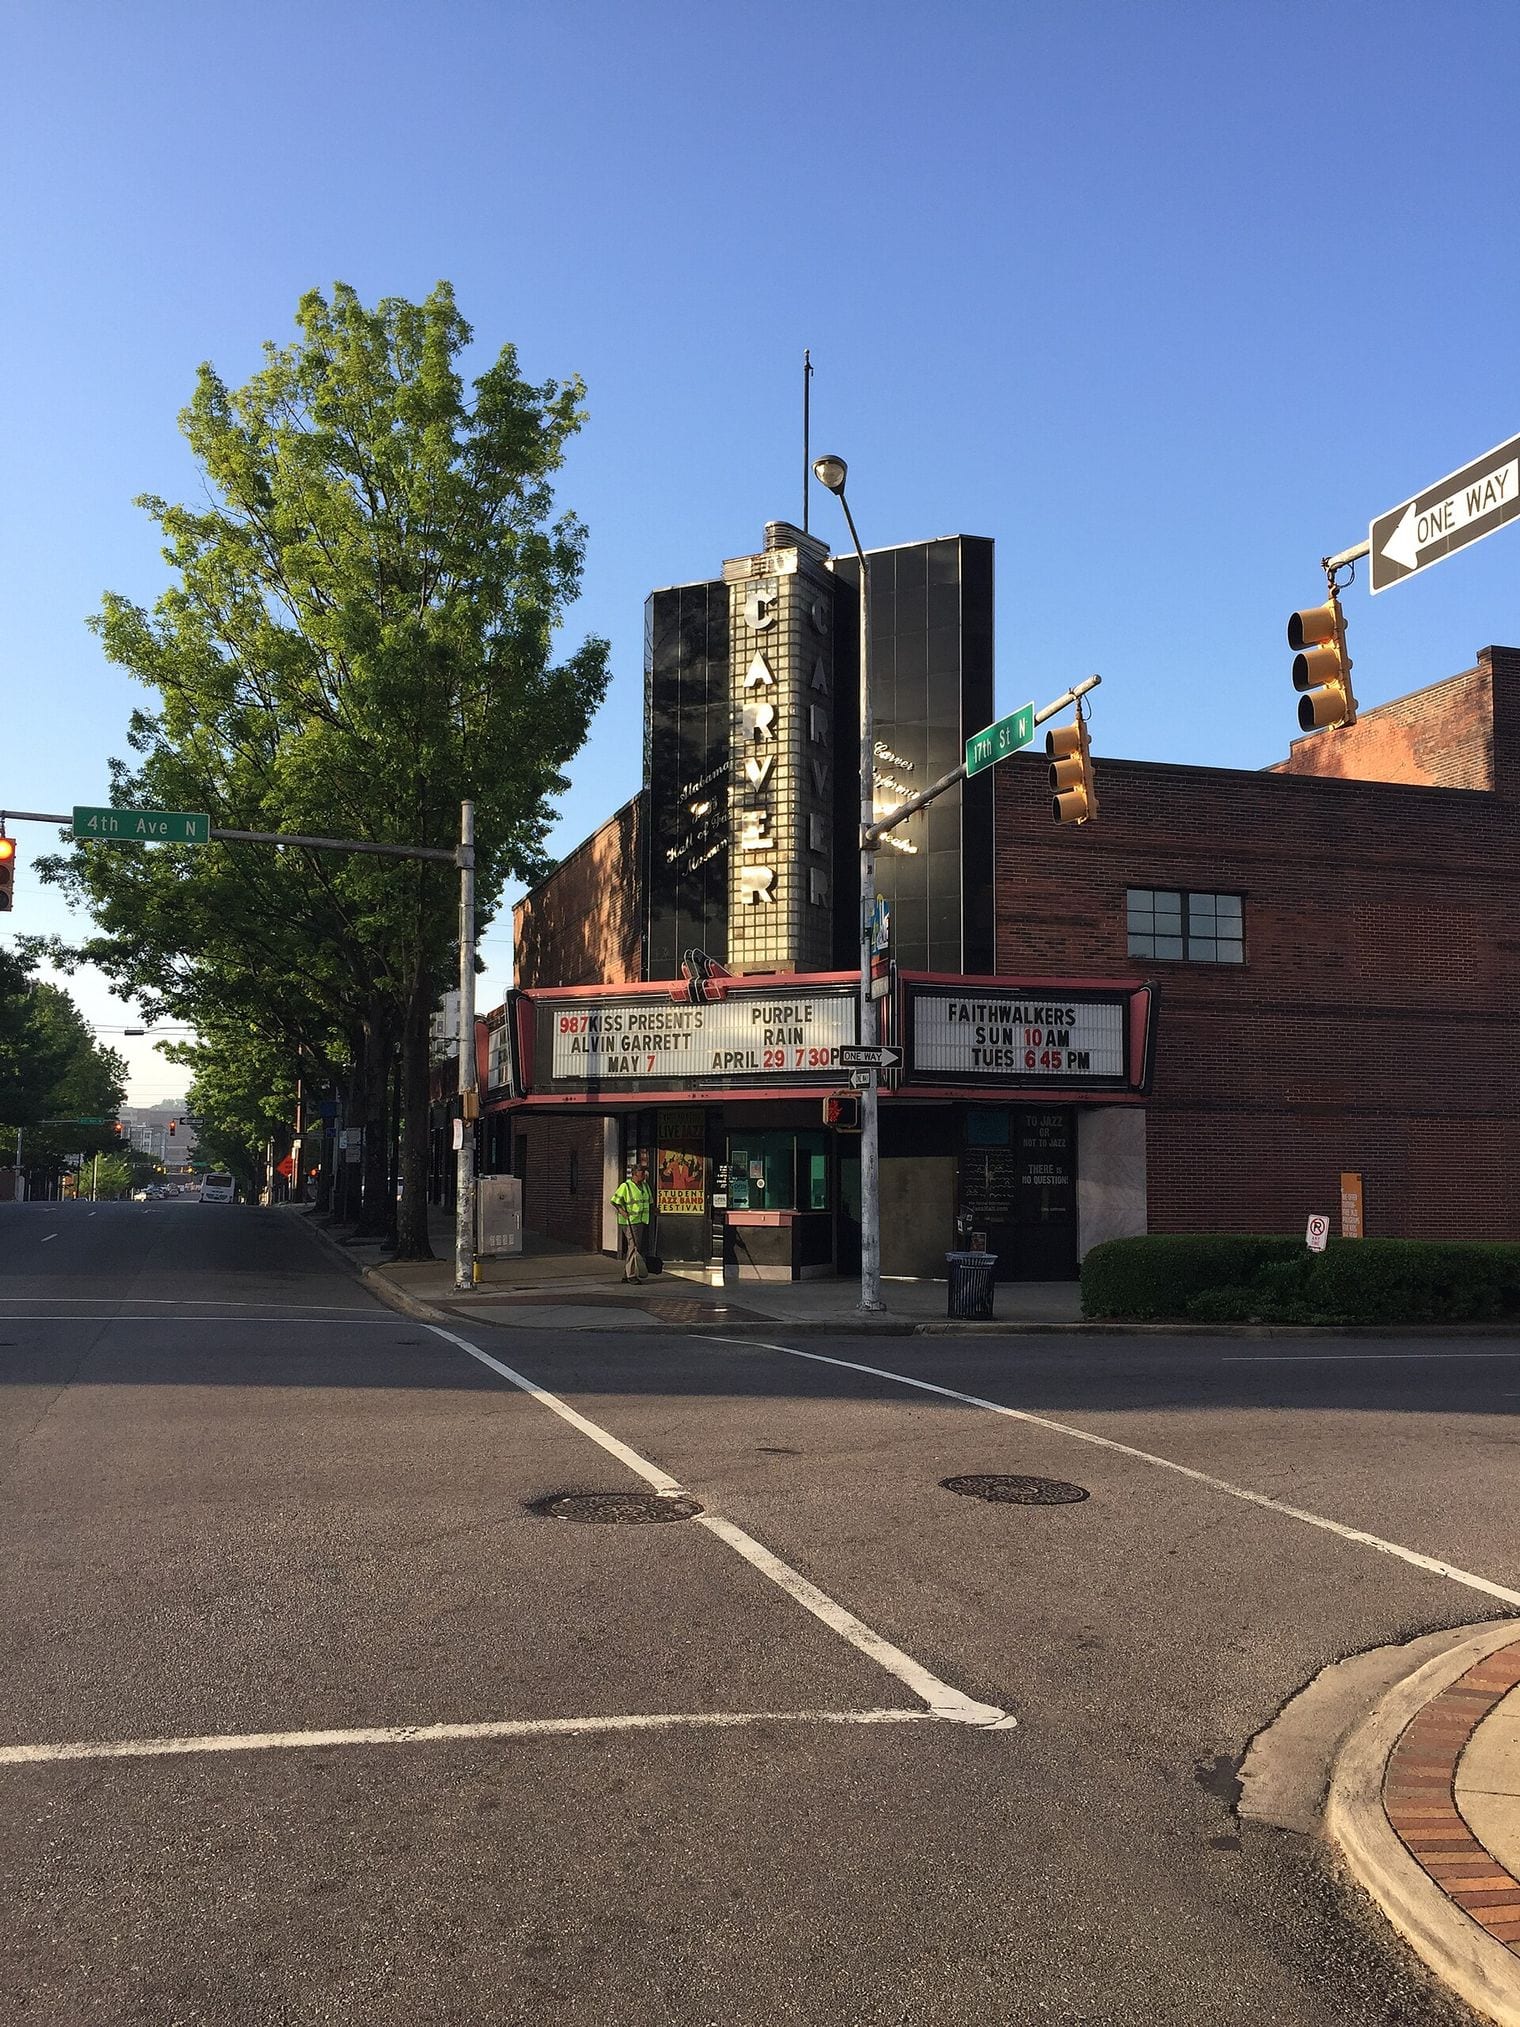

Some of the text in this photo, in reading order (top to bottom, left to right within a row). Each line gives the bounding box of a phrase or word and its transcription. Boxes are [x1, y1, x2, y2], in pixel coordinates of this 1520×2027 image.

[1417, 468, 1509, 543] ONE WAY
[741, 588, 777, 905] CARVER
[974, 717, 1026, 764] 17th St N
[809, 600, 831, 909] CARVER
[873, 741, 914, 771] Carver
[677, 761, 730, 805] Alabama
[87, 815, 196, 836] 4th Ave N
[665, 832, 693, 864] Hall
[697, 821, 709, 840] of
[628, 1011, 704, 1031] PRESENTS
[752, 1005, 813, 1025] PURPLE
[948, 1003, 1076, 1027] FAITHWALKERS
[571, 1033, 691, 1053] ALVIN GARRETT
[764, 1027, 804, 1046] RAIN
[975, 1026, 1013, 1046] SUN
[608, 1055, 656, 1073] MAY 7
[712, 1051, 759, 1069] APRIL
[763, 1049, 785, 1068] 29
[844, 1051, 882, 1060] ONE WAY
[971, 1048, 1014, 1068] TUES
[1026, 1115, 1063, 1127] TO JAZZ
[1039, 1127, 1050, 1137] OR
[1023, 1138, 1066, 1148] NOT TO JAZZ
[1027, 1164, 1055, 1174] THERE
[1022, 1175, 1069, 1185] NO QUESTION!
[658, 1204, 704, 1212] FESTIVAL
